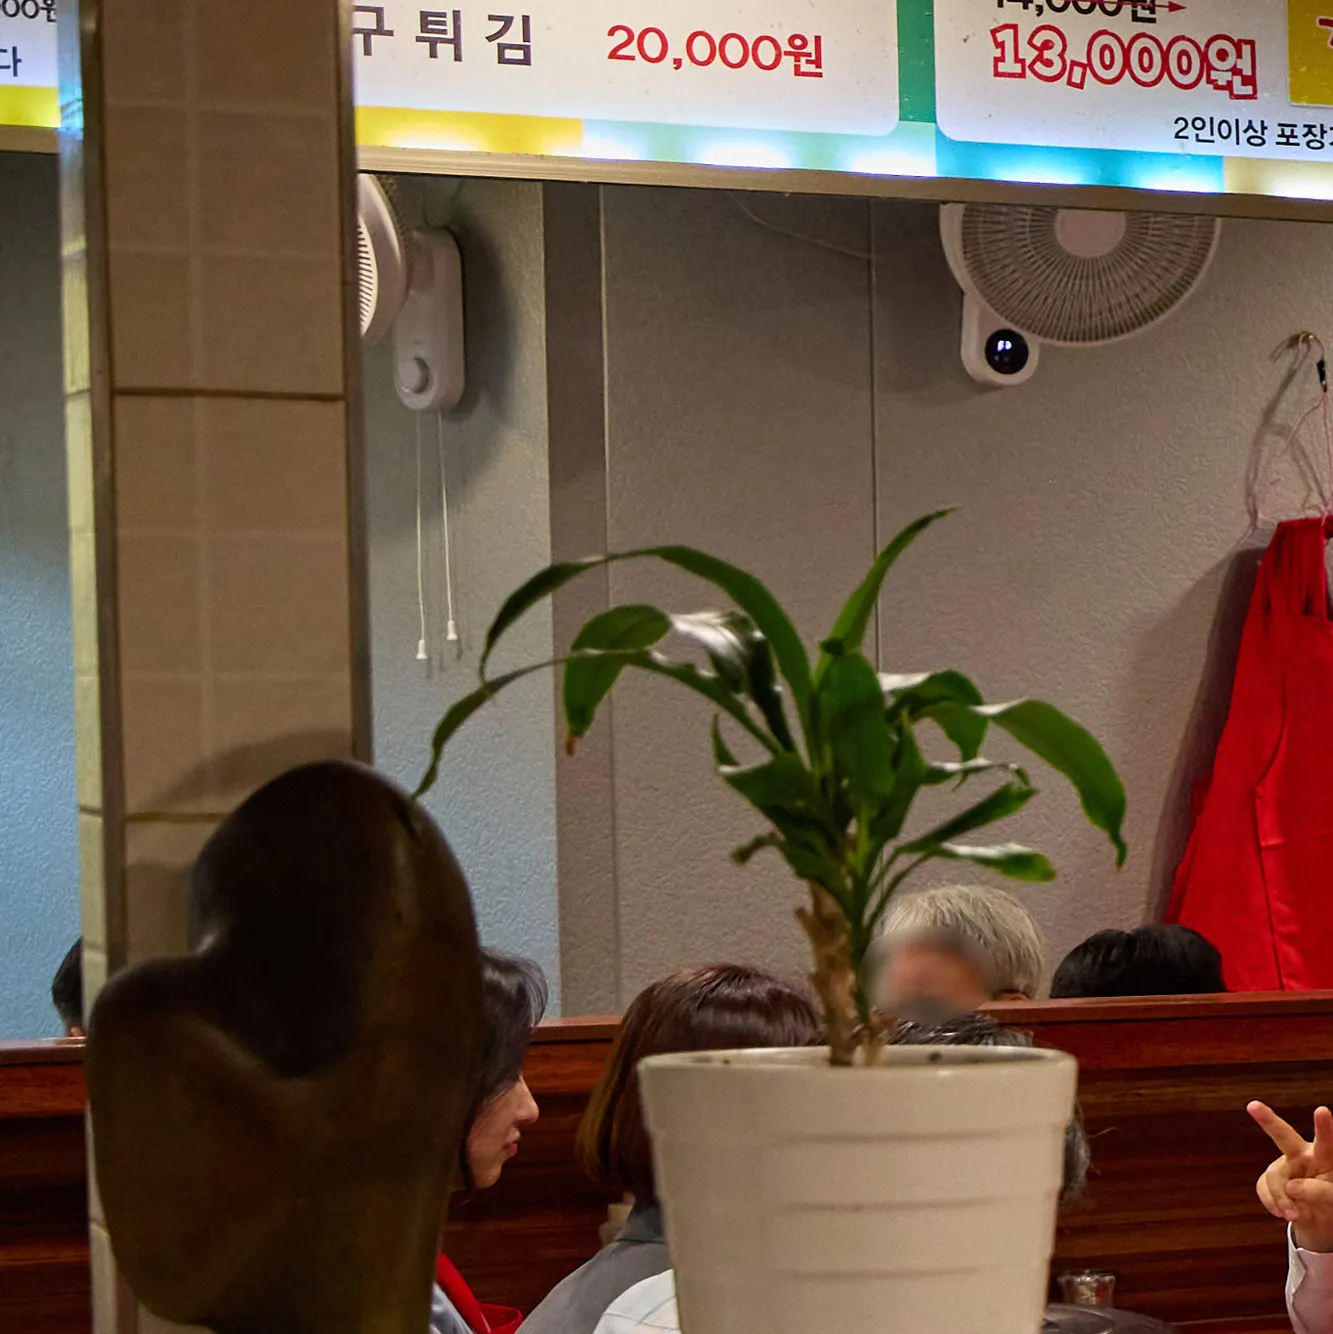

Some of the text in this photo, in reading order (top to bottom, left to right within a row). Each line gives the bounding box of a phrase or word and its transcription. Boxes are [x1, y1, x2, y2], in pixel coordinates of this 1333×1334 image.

[606, 24, 823, 78] 20,000원
[989, 23, 1258, 100] 13,000원
[1173, 116, 1268, 147] 2인이상
